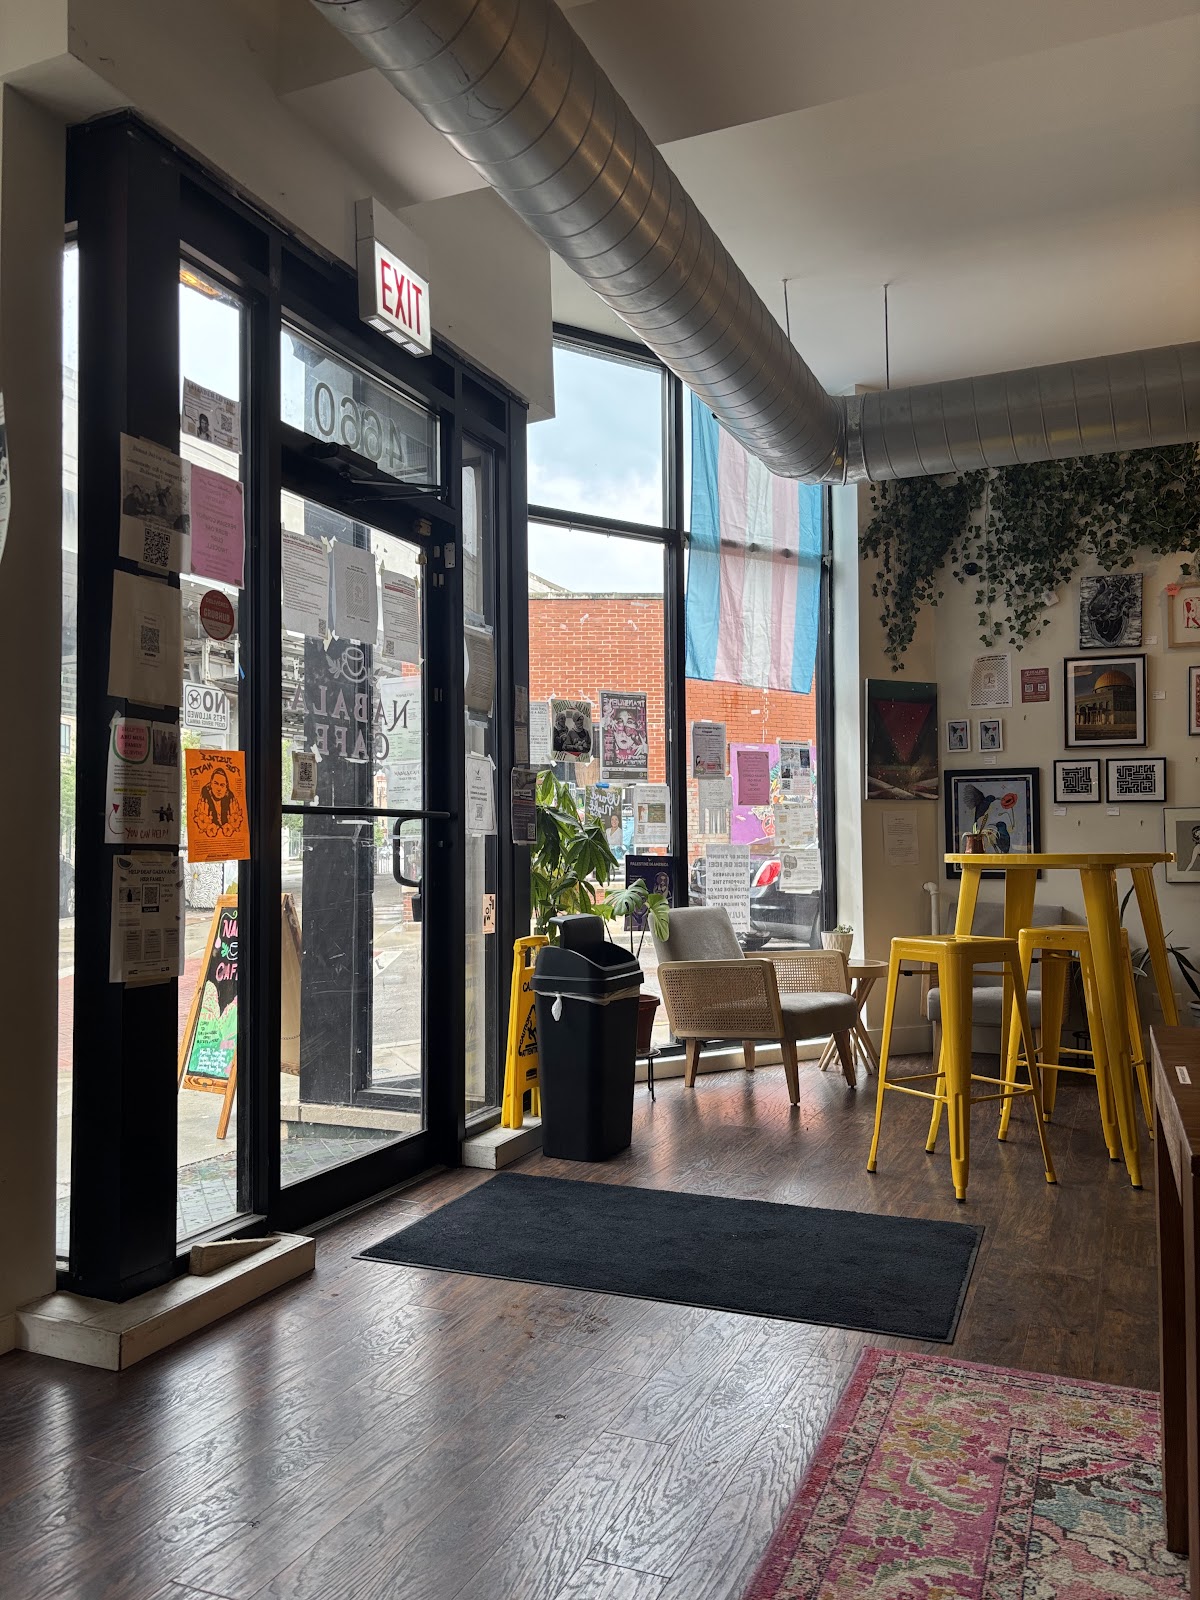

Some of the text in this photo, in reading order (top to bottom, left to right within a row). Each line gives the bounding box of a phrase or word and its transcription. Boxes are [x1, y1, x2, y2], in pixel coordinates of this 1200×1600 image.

[380, 258, 422, 336] EXIT
[203, 608, 231, 623] GRUBHUB
[125, 827, 169, 839] YOU CAN HELP!
[519, 1014, 531, 1045] CAUTION
